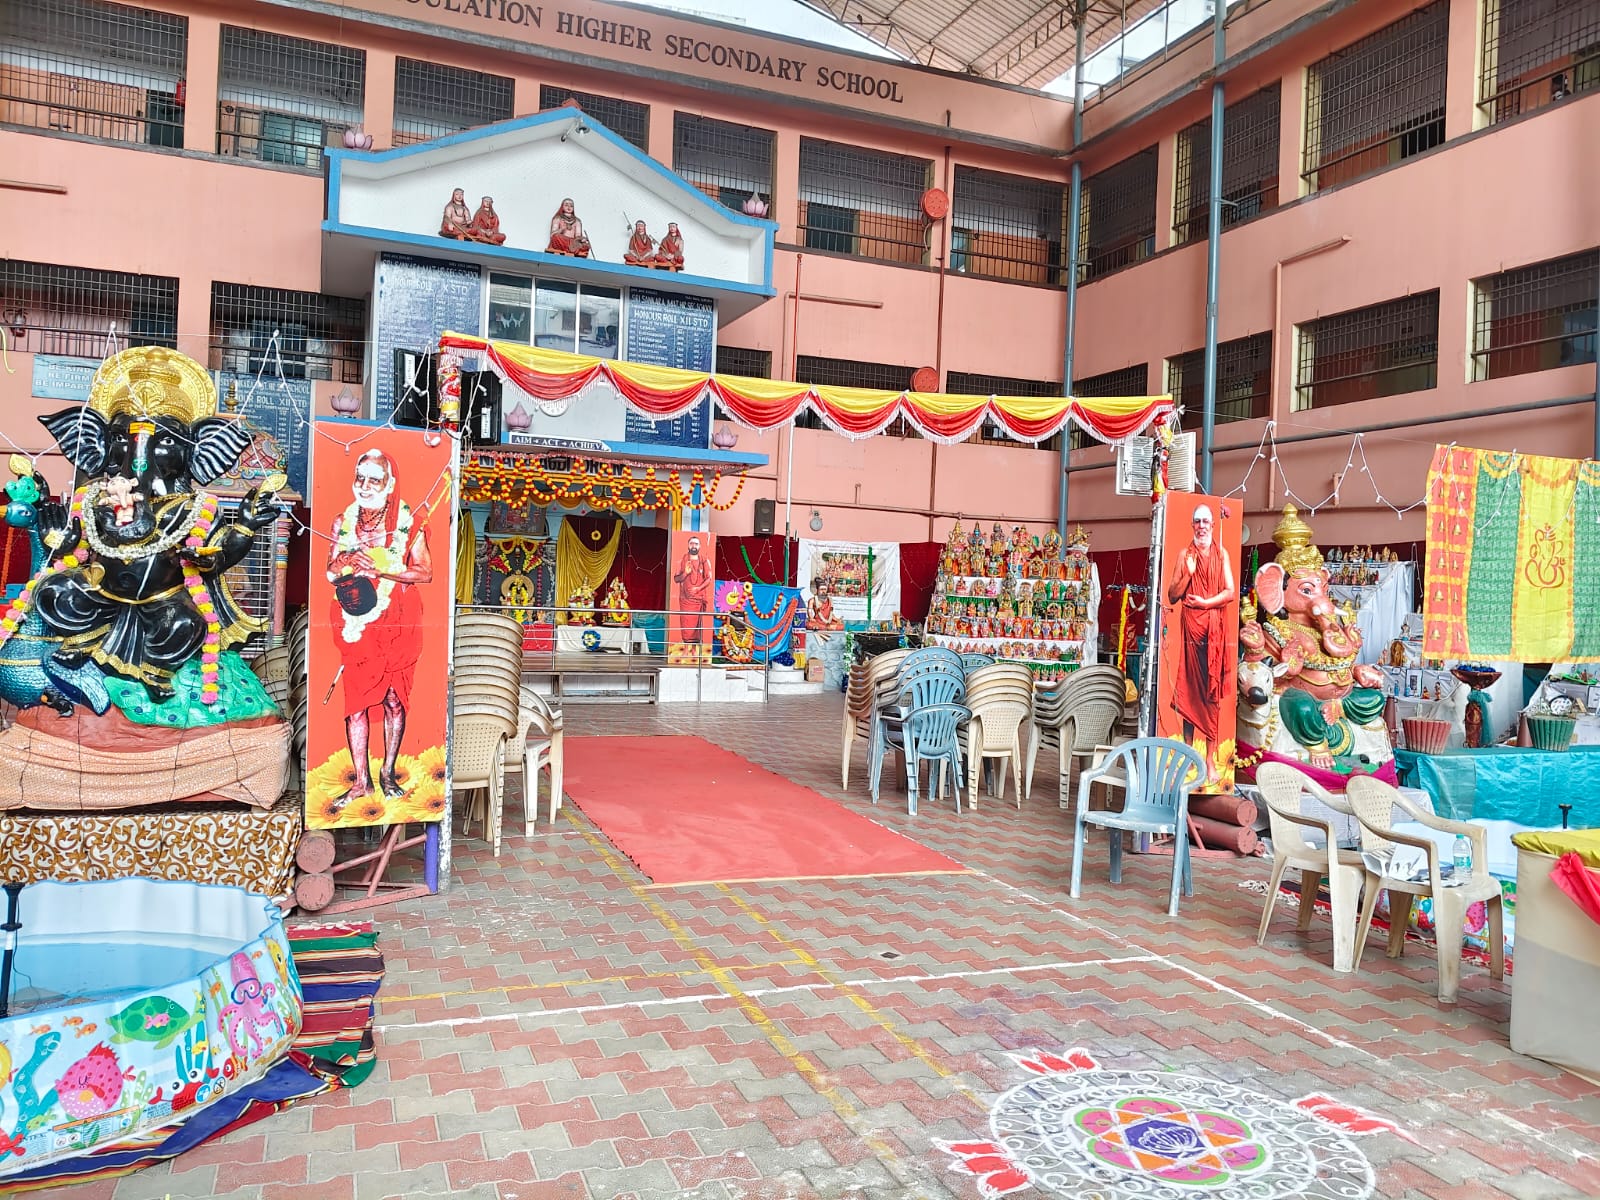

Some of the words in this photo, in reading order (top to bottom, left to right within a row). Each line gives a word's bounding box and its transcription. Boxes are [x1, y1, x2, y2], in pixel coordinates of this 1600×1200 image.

[555, 11, 652, 52] HIGHER
[664, 34, 806, 83] SECONDARY
[817, 66, 904, 104] SCHOOL
[450, 284, 468, 296] STD
[634, 309, 662, 322] HONOUR
[663, 313, 678, 324] ROLL
[692, 318, 709, 328] STD
[35, 379, 49, 387] BE
[52, 381, 91, 390] IMPART
[256, 395, 275, 406] ROLL
[514, 436, 532, 444] AIM
[542, 438, 559, 446] ACT
